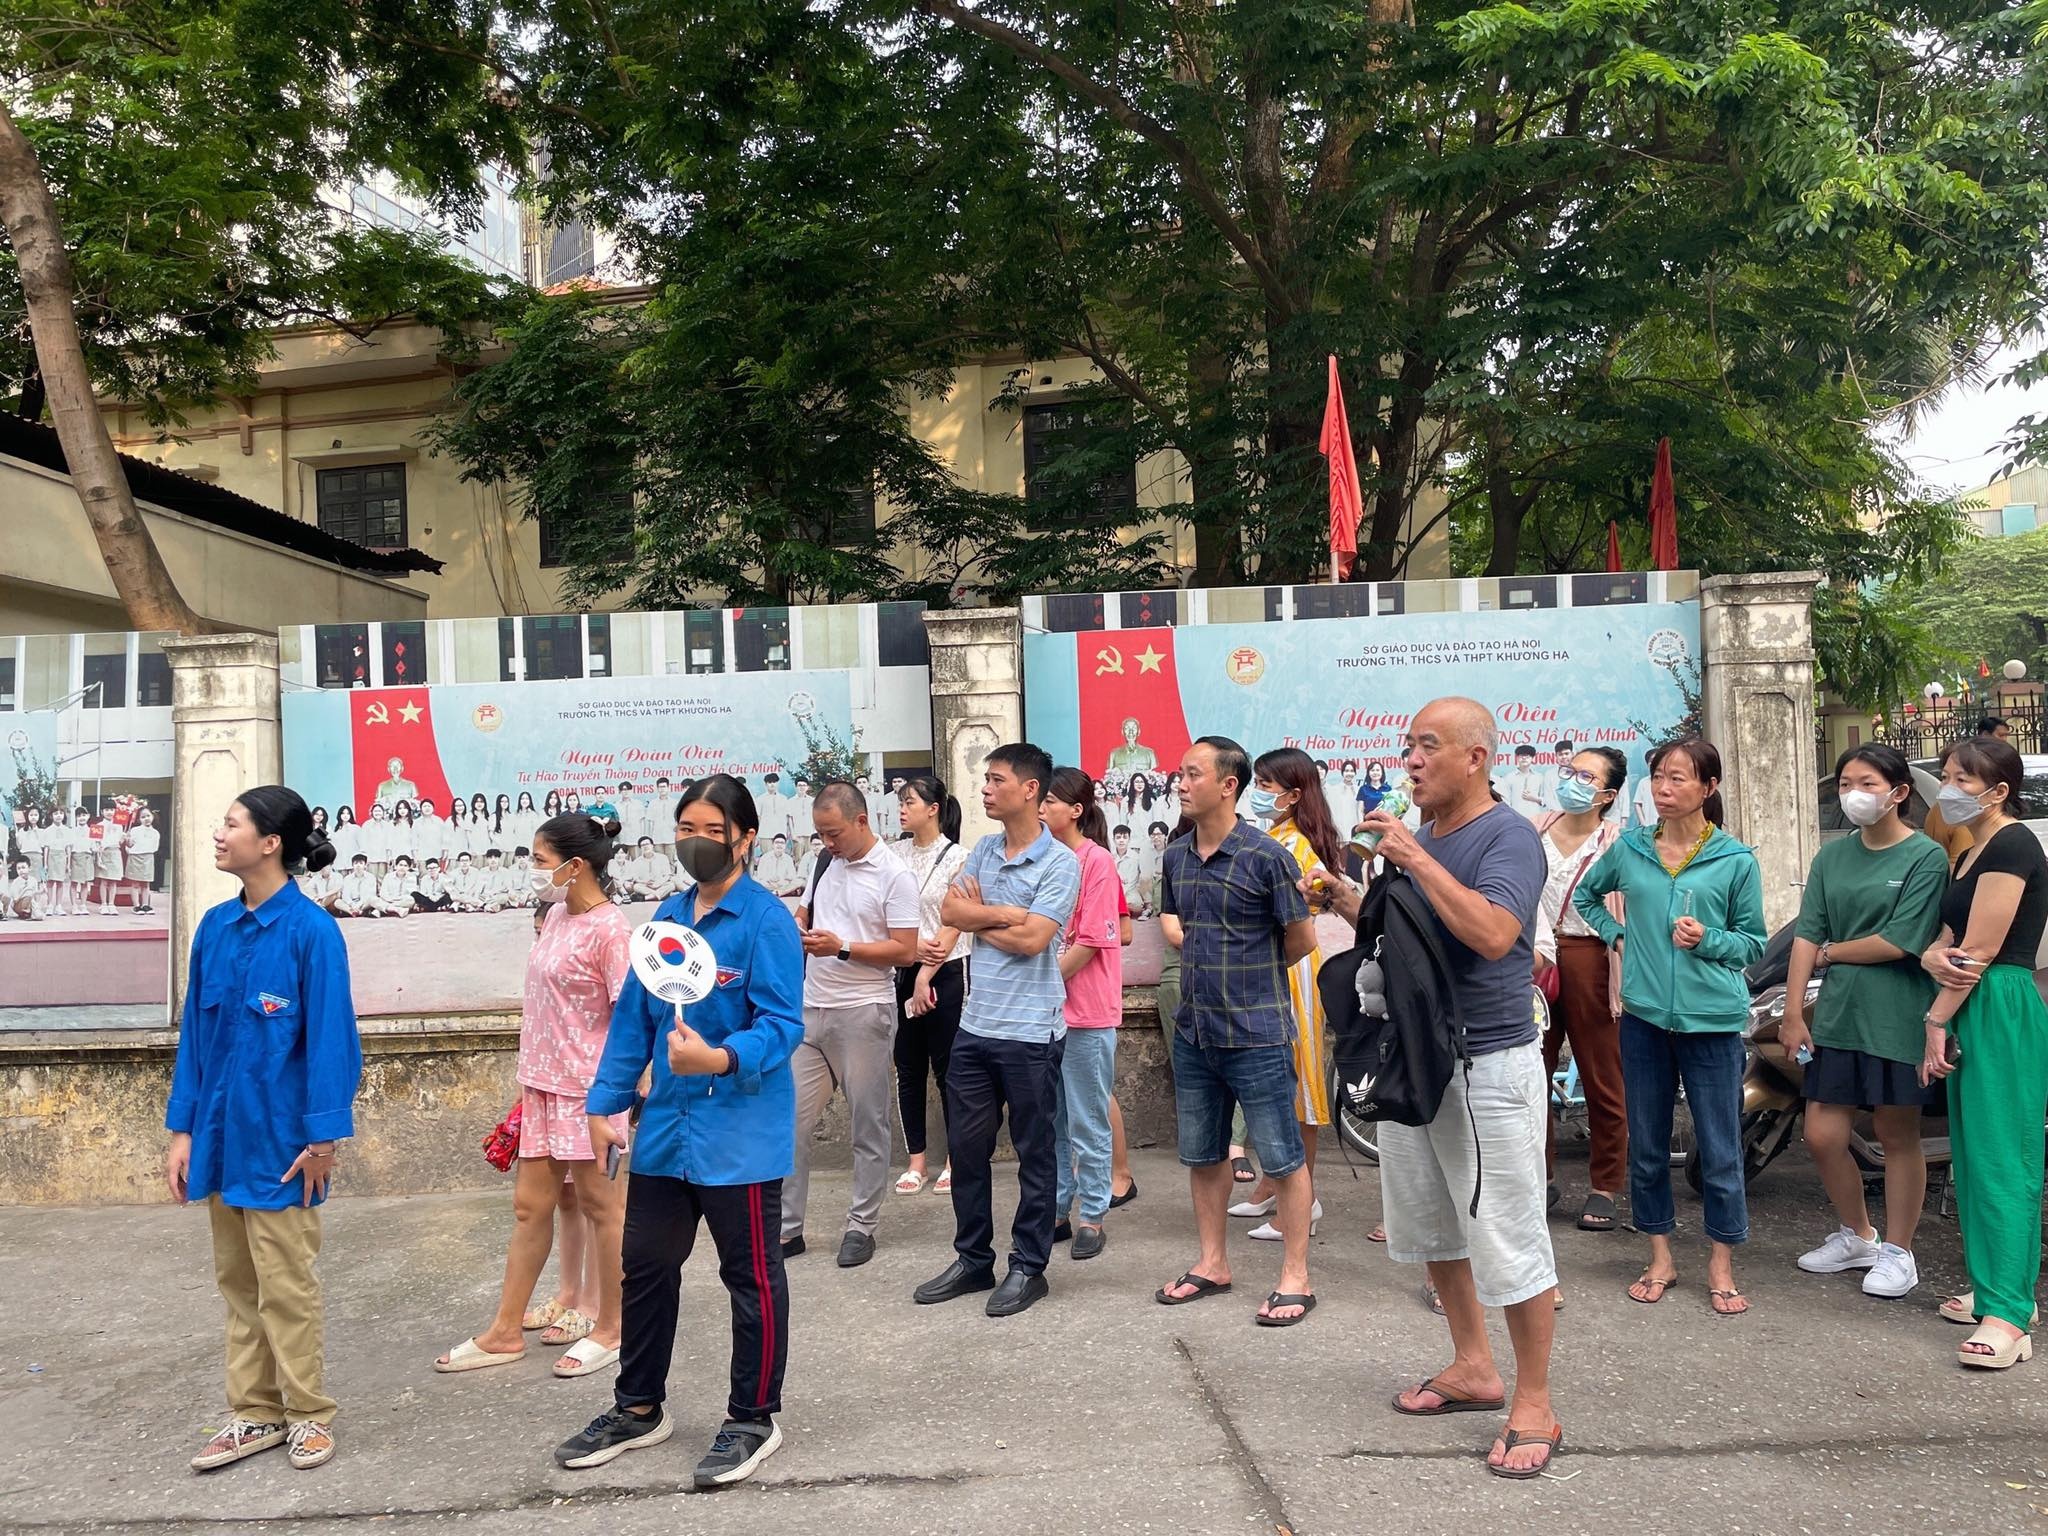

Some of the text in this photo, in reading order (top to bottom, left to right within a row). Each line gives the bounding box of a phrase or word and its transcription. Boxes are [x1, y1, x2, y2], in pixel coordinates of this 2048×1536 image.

[1411, 655, 1441, 664] THCS
[1464, 653, 1493, 663] THPT
[615, 709, 638, 717] THCS
[1339, 702, 1558, 731] Ngày Viên
[1305, 734, 1335, 750] Hào
[1341, 733, 1390, 752] Truyền
[1536, 727, 1559, 744] Hồ
[1564, 728, 1589, 744] Chí
[1595, 727, 1638, 742] Minh
[677, 765, 705, 777] TNCS
[751, 762, 781, 773] Minh
